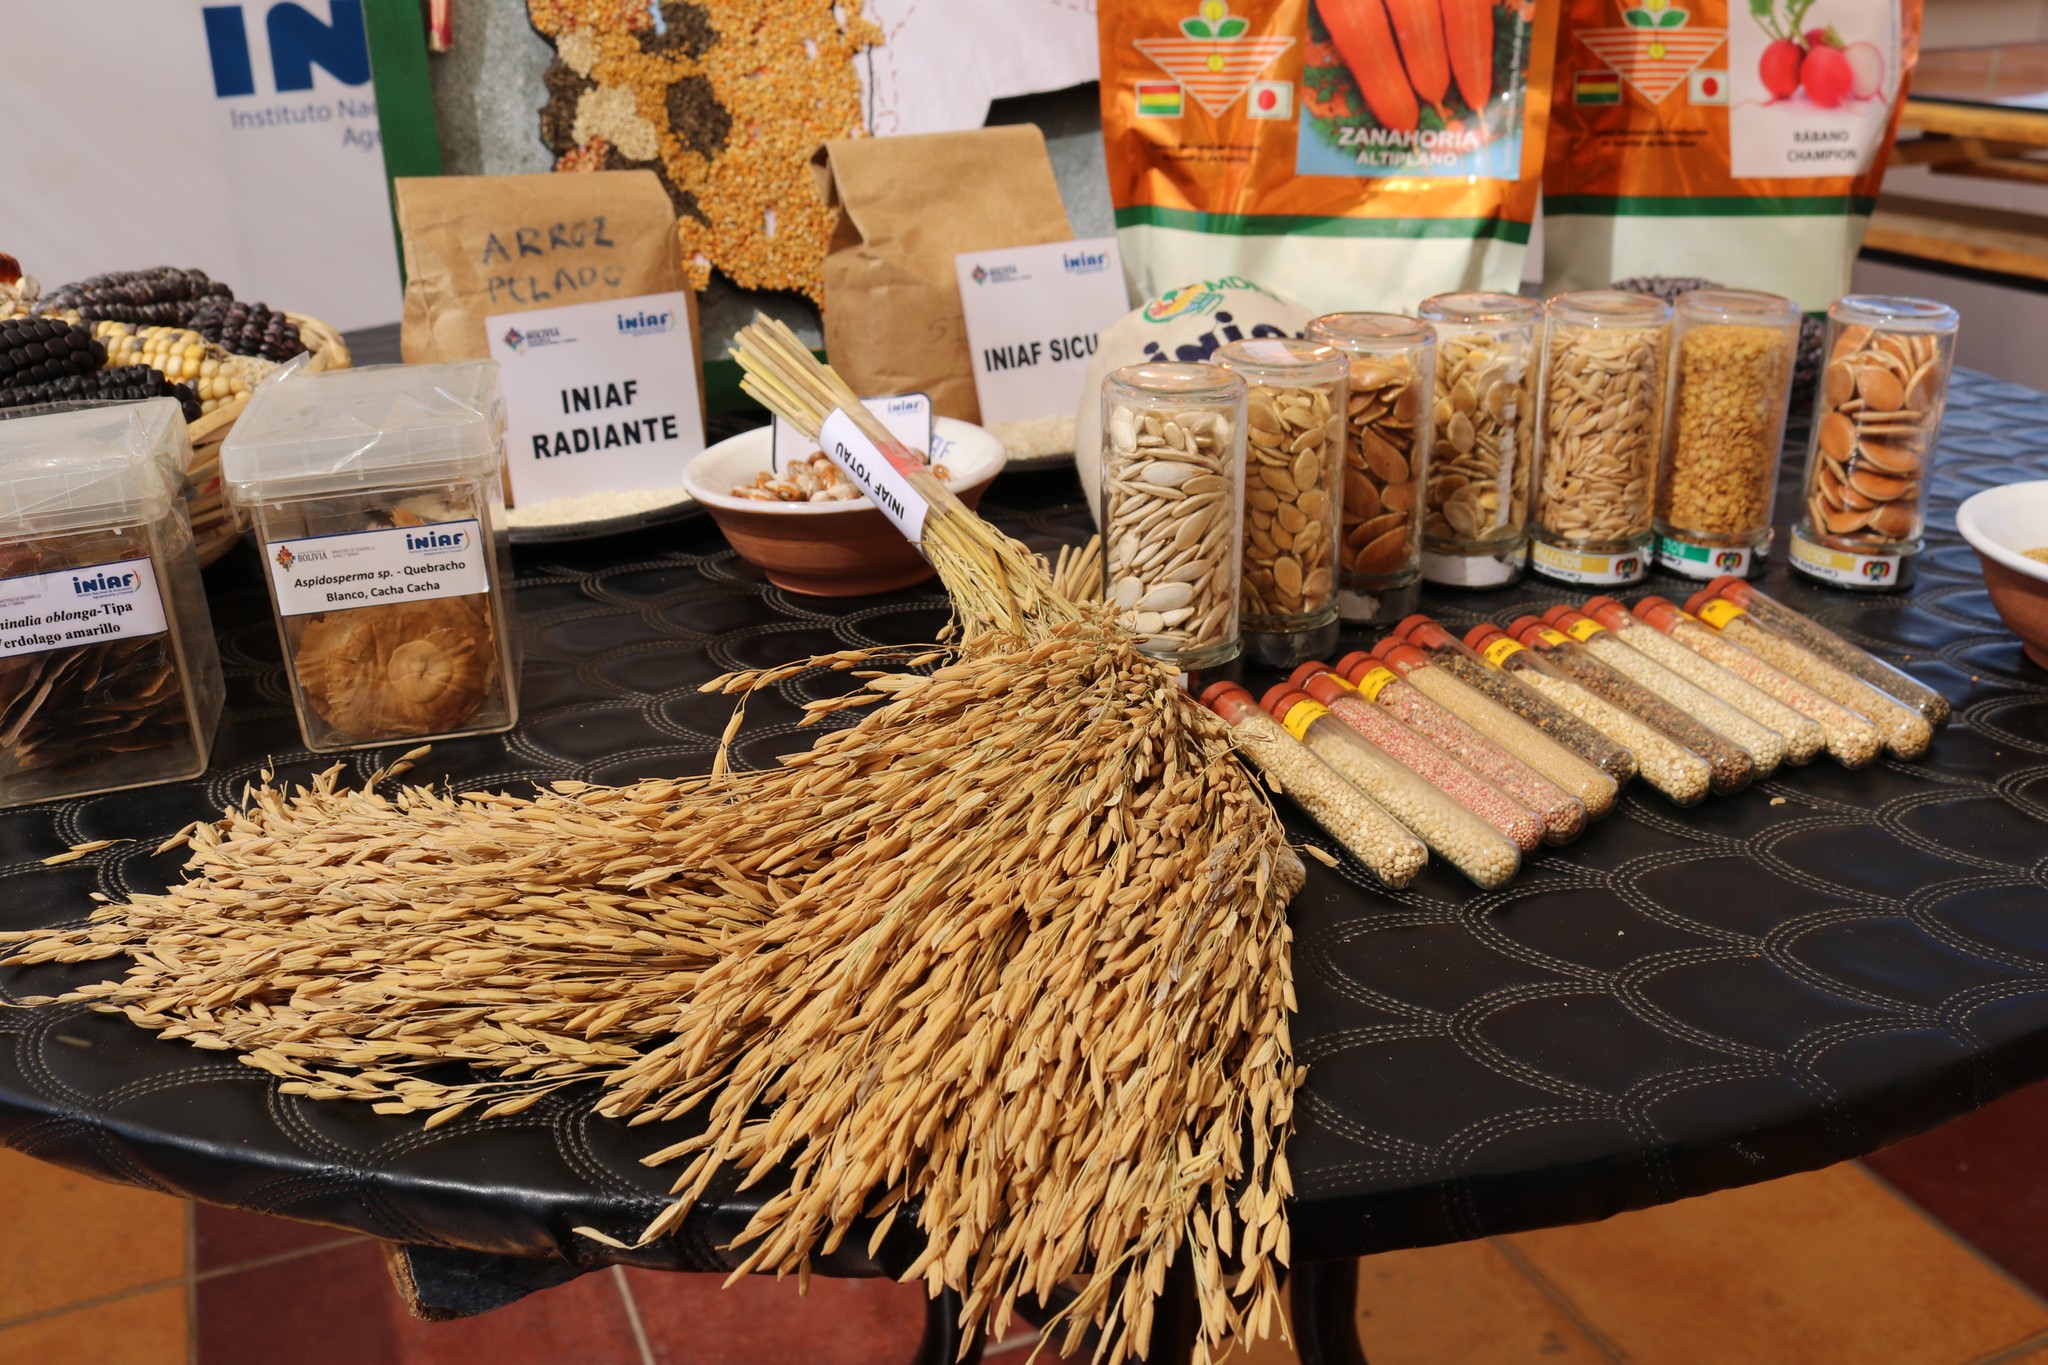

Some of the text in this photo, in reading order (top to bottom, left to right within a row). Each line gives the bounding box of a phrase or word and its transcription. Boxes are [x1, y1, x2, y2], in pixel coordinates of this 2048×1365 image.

[230, 104, 333, 129] Instituto
[1338, 127, 1480, 149] ZANAHORIA
[1356, 150, 1458, 167] ALTIPLANO
[1787, 148, 1857, 163] CHAMPION
[483, 216, 614, 266] ARROZ
[984, 341, 1042, 372] INIAF
[561, 380, 638, 415] INIAF
[532, 415, 679, 460] RADIANTE
[835, 442, 905, 520] INIAF YOTAU
[297, 551, 328, 562] BOLIVIA
[294, 570, 375, 589] Aspidosperma
[377, 569, 394, 579] sp.
[403, 560, 466, 576] Quebracho
[326, 581, 441, 603] Blanco, Cacha Cacha
[45, 602, 133, 624] oblonga-Tipa
[65, 622, 121, 640] amarillo
